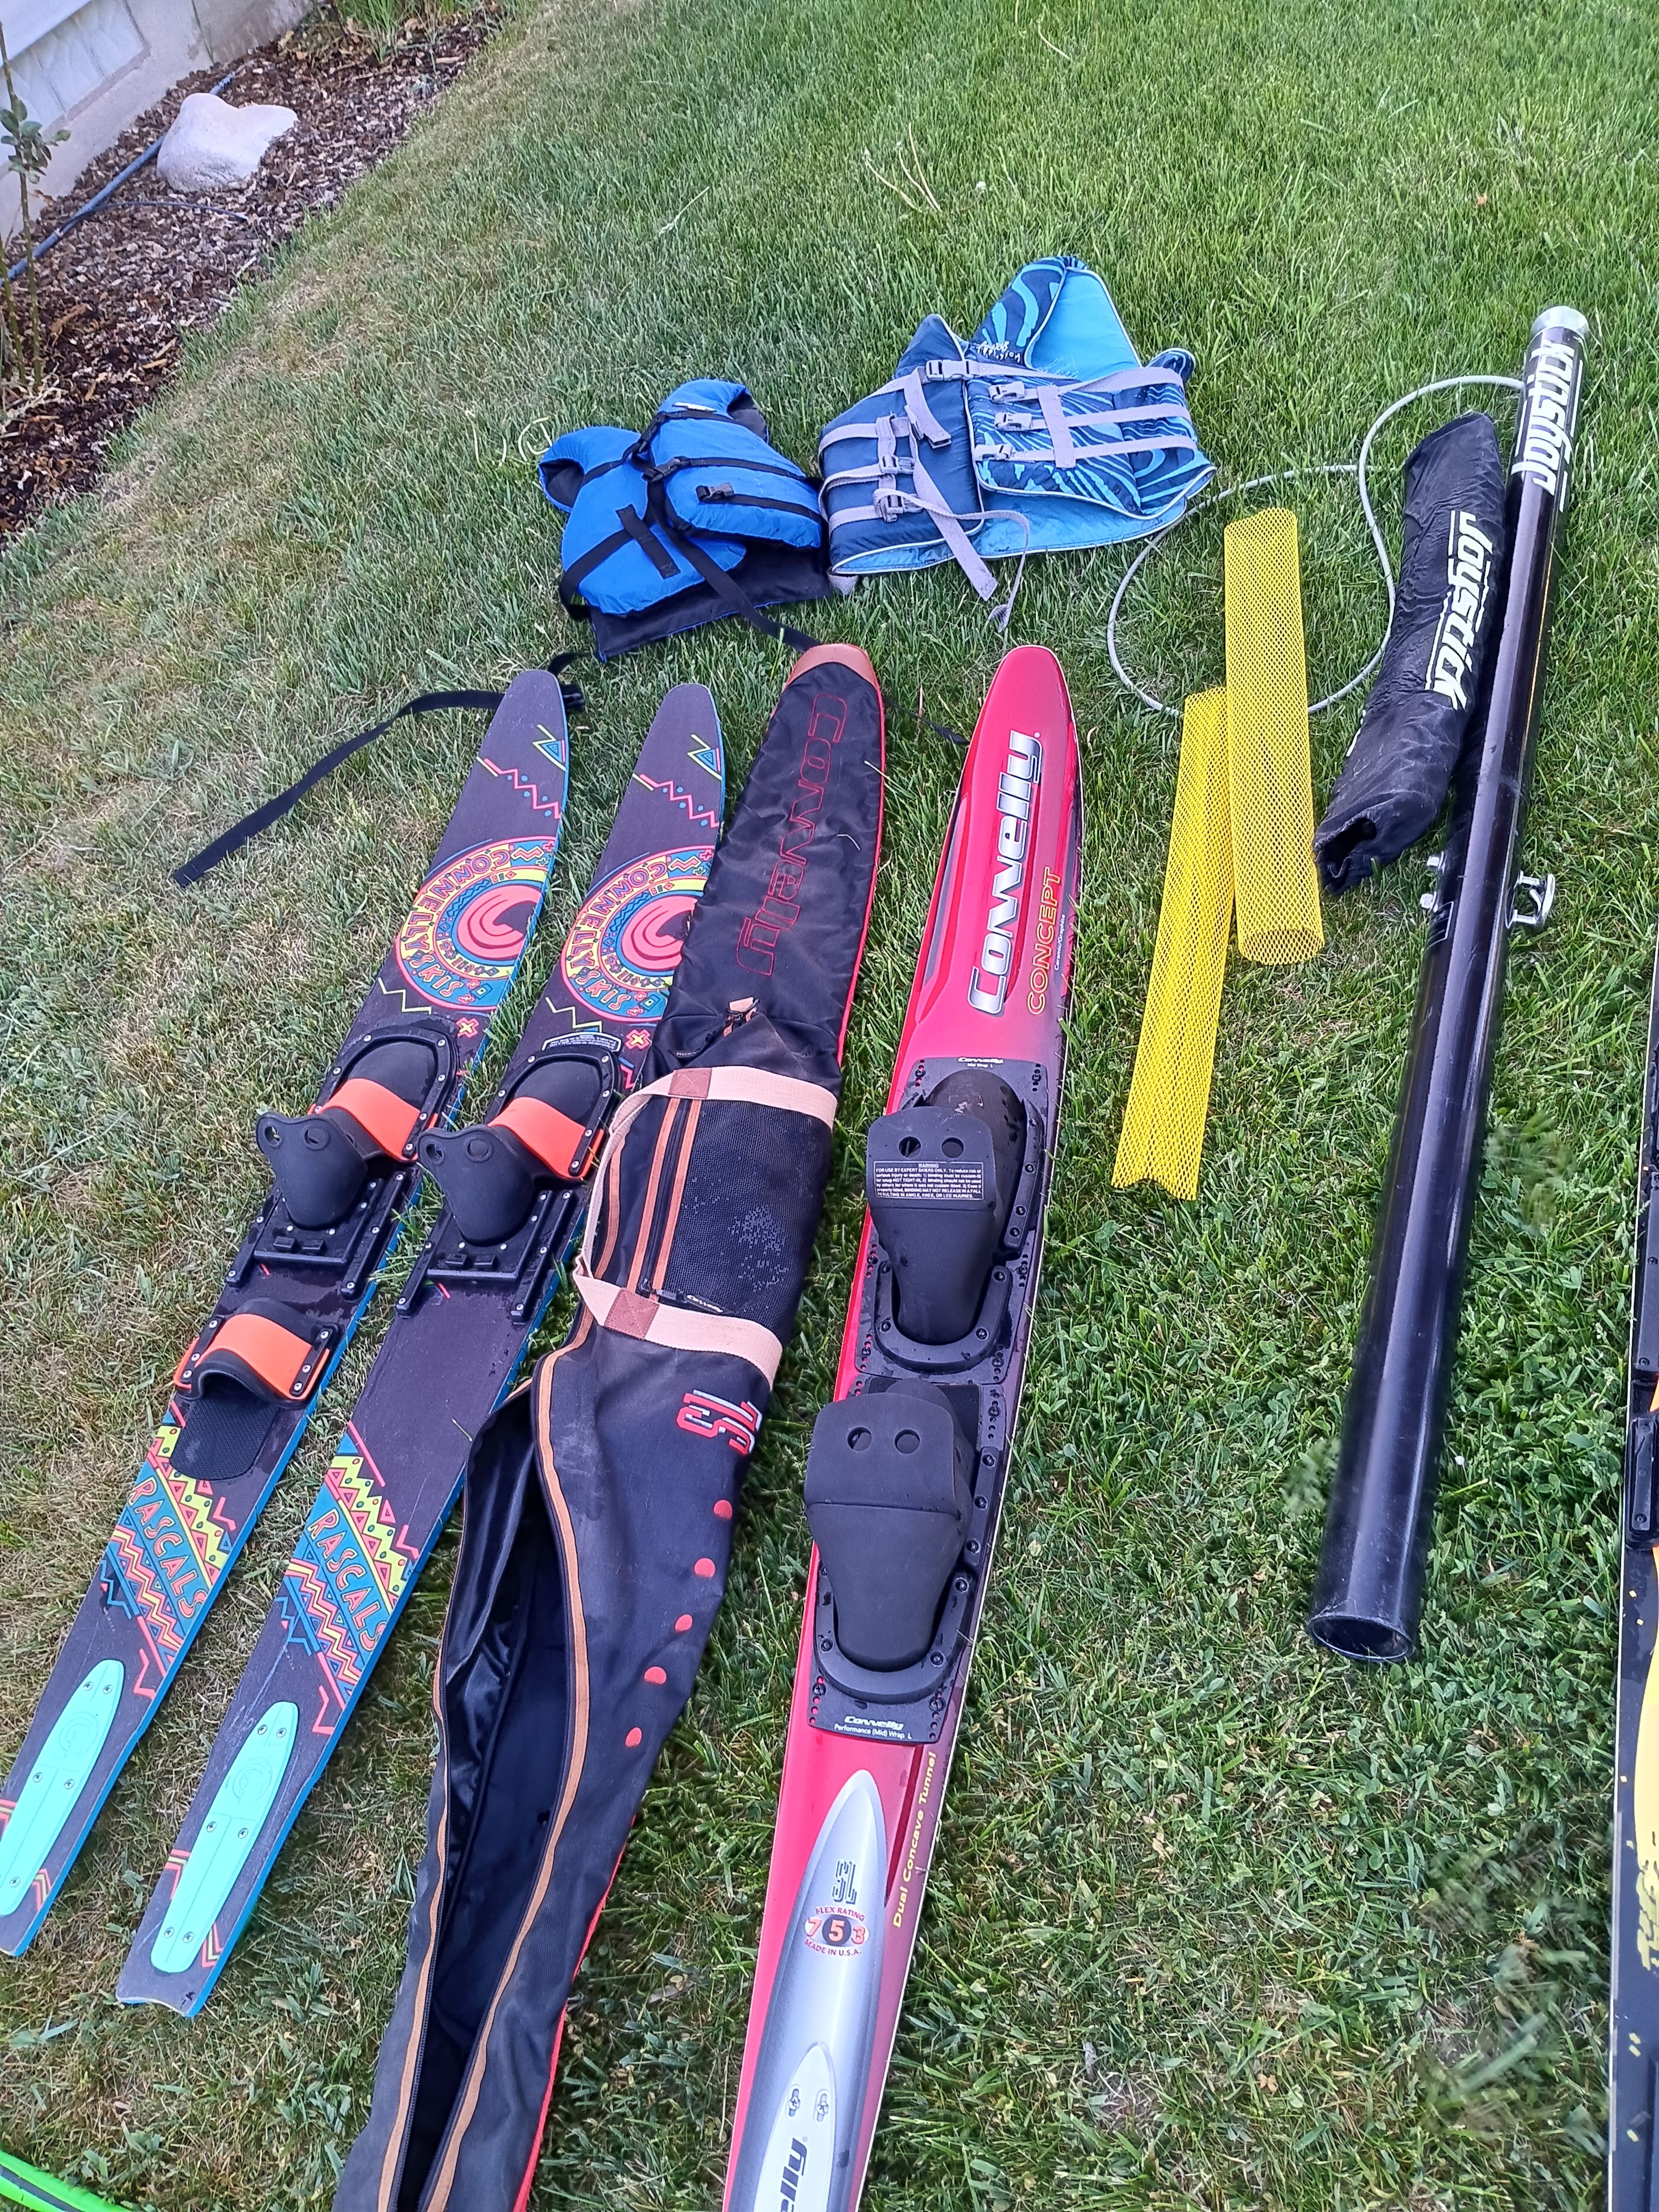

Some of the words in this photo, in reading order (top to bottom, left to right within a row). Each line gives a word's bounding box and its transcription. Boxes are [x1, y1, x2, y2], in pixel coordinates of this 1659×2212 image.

[1512, 340, 1576, 496] Joystick
[404, 850, 512, 953] CONNELLY
[967, 729, 1042, 1015] Connelly
[570, 861, 667, 968] CONNELLY
[1027, 867, 1062, 1016] CONCEPT
[1053, 914, 1066, 971] Ceramic/Graphite
[410, 954, 462, 996] SKIS
[576, 969, 630, 1010] SKIS
[128, 1478, 208, 1619] RASCALS
[306, 1508, 387, 1653] RASCALS
[834, 1724, 871, 1734] Performance
[872, 1728, 888, 1737] (Mid)
[889, 1731, 905, 1740] Wrap
[844, 1716, 904, 1731] Connelly
[892, 1886, 909, 1928] Dual
[902, 1810, 925, 1883] Concave
[918, 1751, 937, 1805] Tunnel
[804, 1939, 826, 1953] MADE
[807, 1917, 822, 1937] 7
[828, 1919, 845, 1942] 5
[851, 1925, 866, 1944] 3
[838, 1908, 865, 1921] RATING
